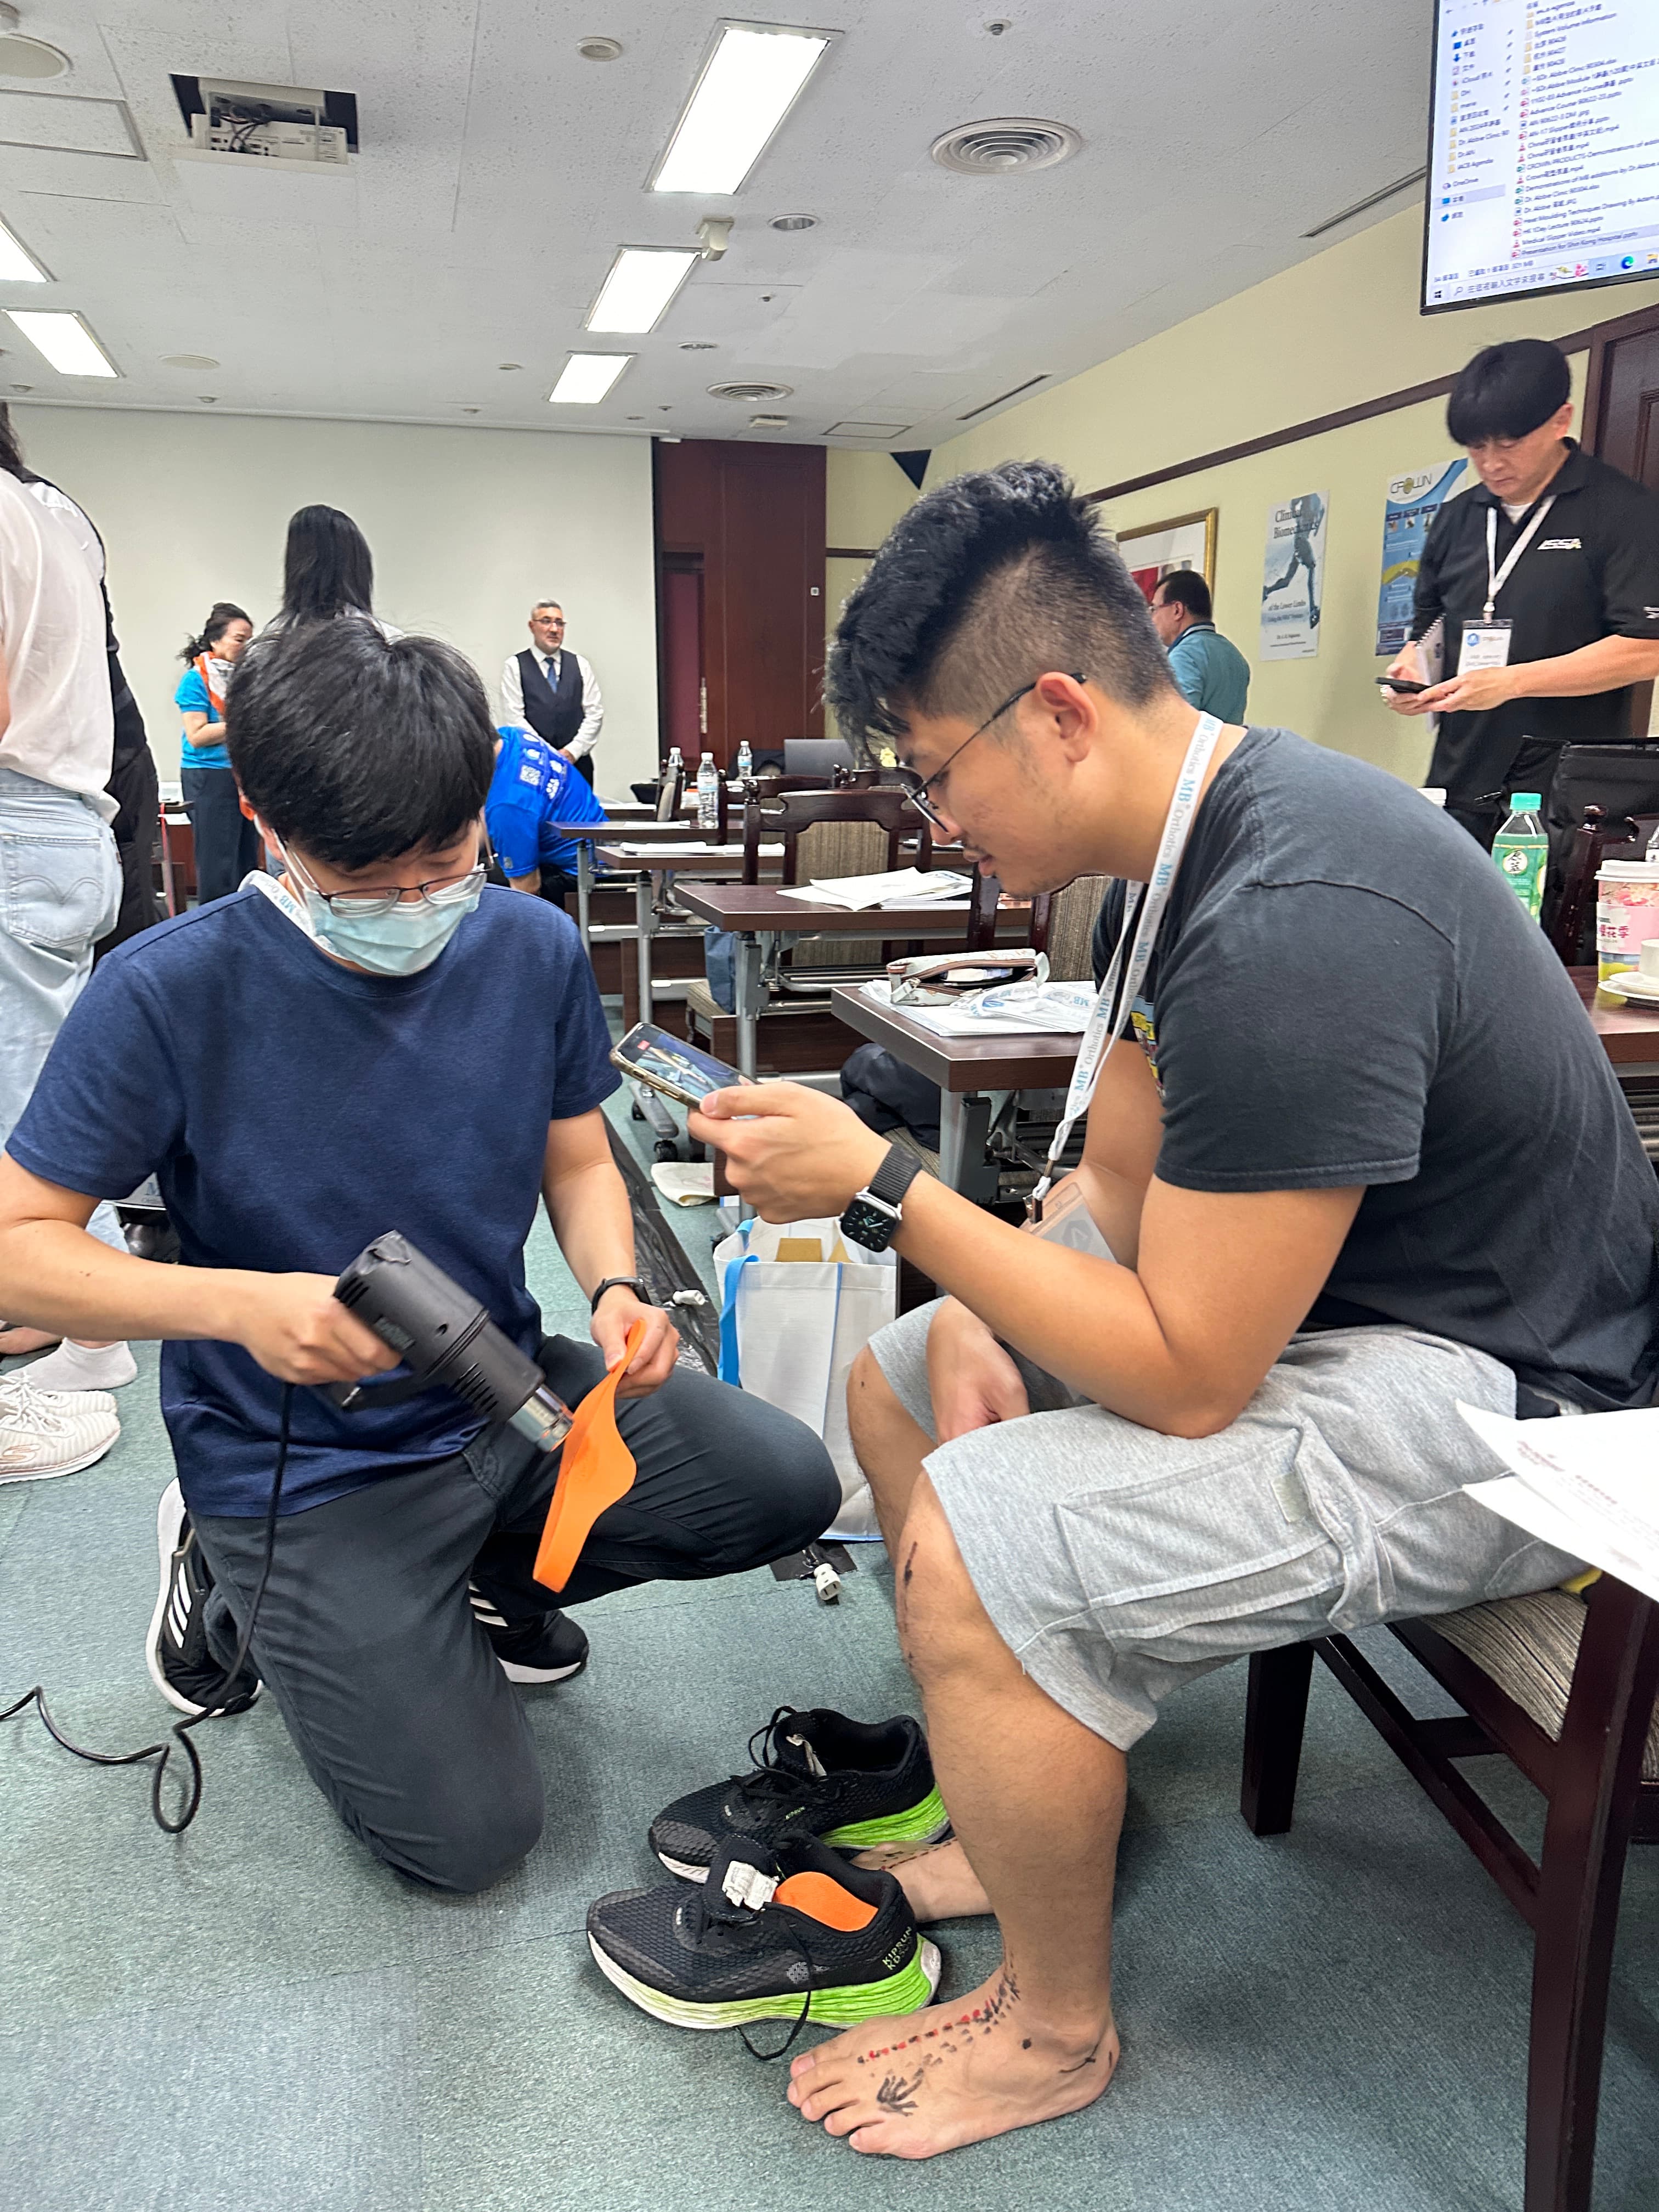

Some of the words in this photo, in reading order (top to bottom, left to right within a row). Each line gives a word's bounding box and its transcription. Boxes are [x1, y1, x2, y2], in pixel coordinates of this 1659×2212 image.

[1391, 472, 1432, 494] CROWN
[1177, 778, 1196, 802] MB
[1163, 809, 1184, 858] Orthotics
[1155, 863, 1172, 885] MB
[1134, 942, 1149, 962] MB
[1075, 1071, 1089, 1091] MB
[1084, 1023, 1104, 1065] Orthotics
[1097, 998, 1110, 1019] MB
[882, 1926, 912, 1965] KIPRUN
